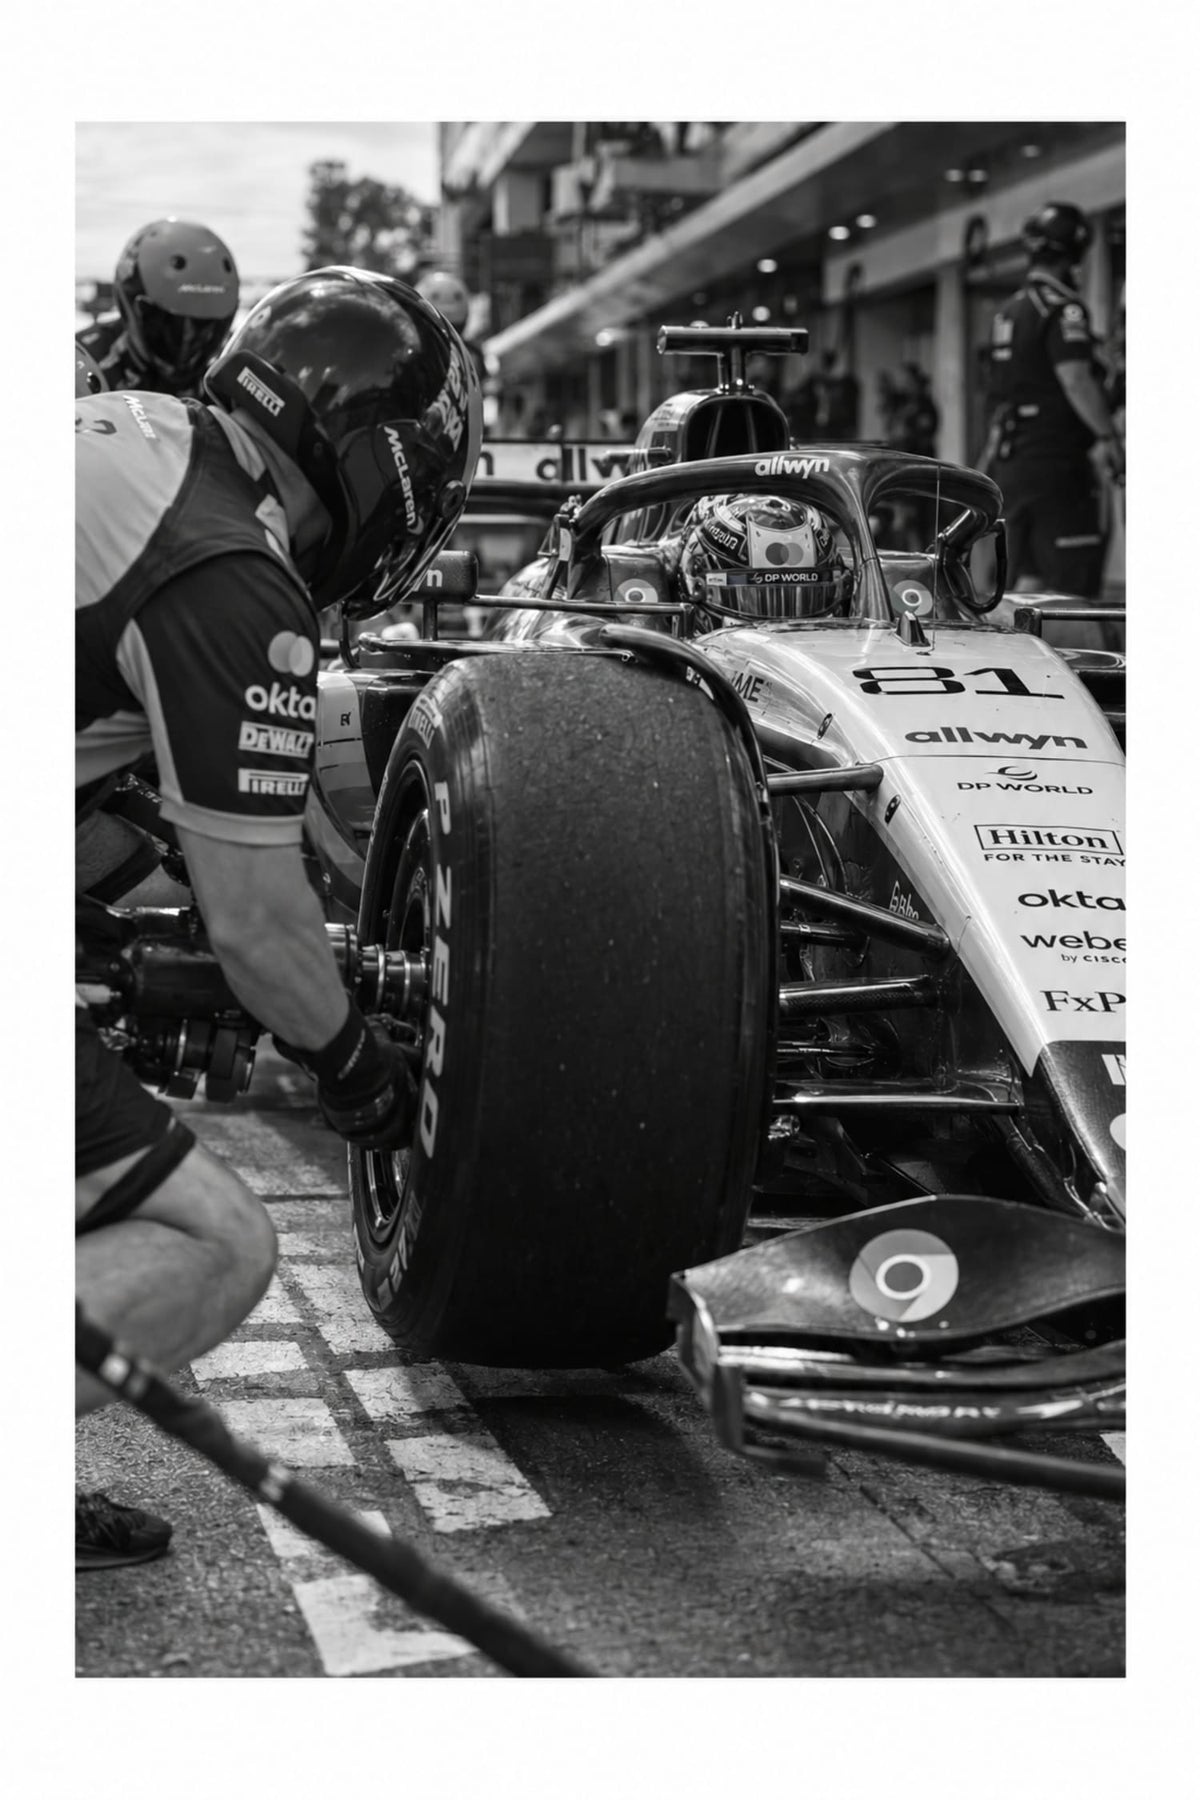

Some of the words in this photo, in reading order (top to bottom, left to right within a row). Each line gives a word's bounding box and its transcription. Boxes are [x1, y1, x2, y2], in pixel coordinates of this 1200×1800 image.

[237, 366, 286, 417] PIRELLI
[384, 425, 417, 527] McLaren
[754, 456, 830, 480] allwyn
[764, 573, 780, 583] DP
[781, 571, 819, 583] WORLD
[852, 666, 1065, 699] 81
[244, 681, 317, 720] okta
[904, 726, 1089, 750] allwyn
[956, 782, 991, 791] DP
[997, 782, 1094, 796] WORLD
[434, 781, 452, 835] P
[987, 828, 1110, 850] Hilton
[983, 853, 1026, 863] FOR
[1031, 853, 1073, 863] THE
[1080, 855, 1126, 868] STAY
[1017, 888, 1126, 911] okta
[1060, 953, 1078, 964] by
[1082, 955, 1126, 964] cisc
[419, 863, 453, 1159] ZERO
[1039, 989, 1126, 1014] FxP
